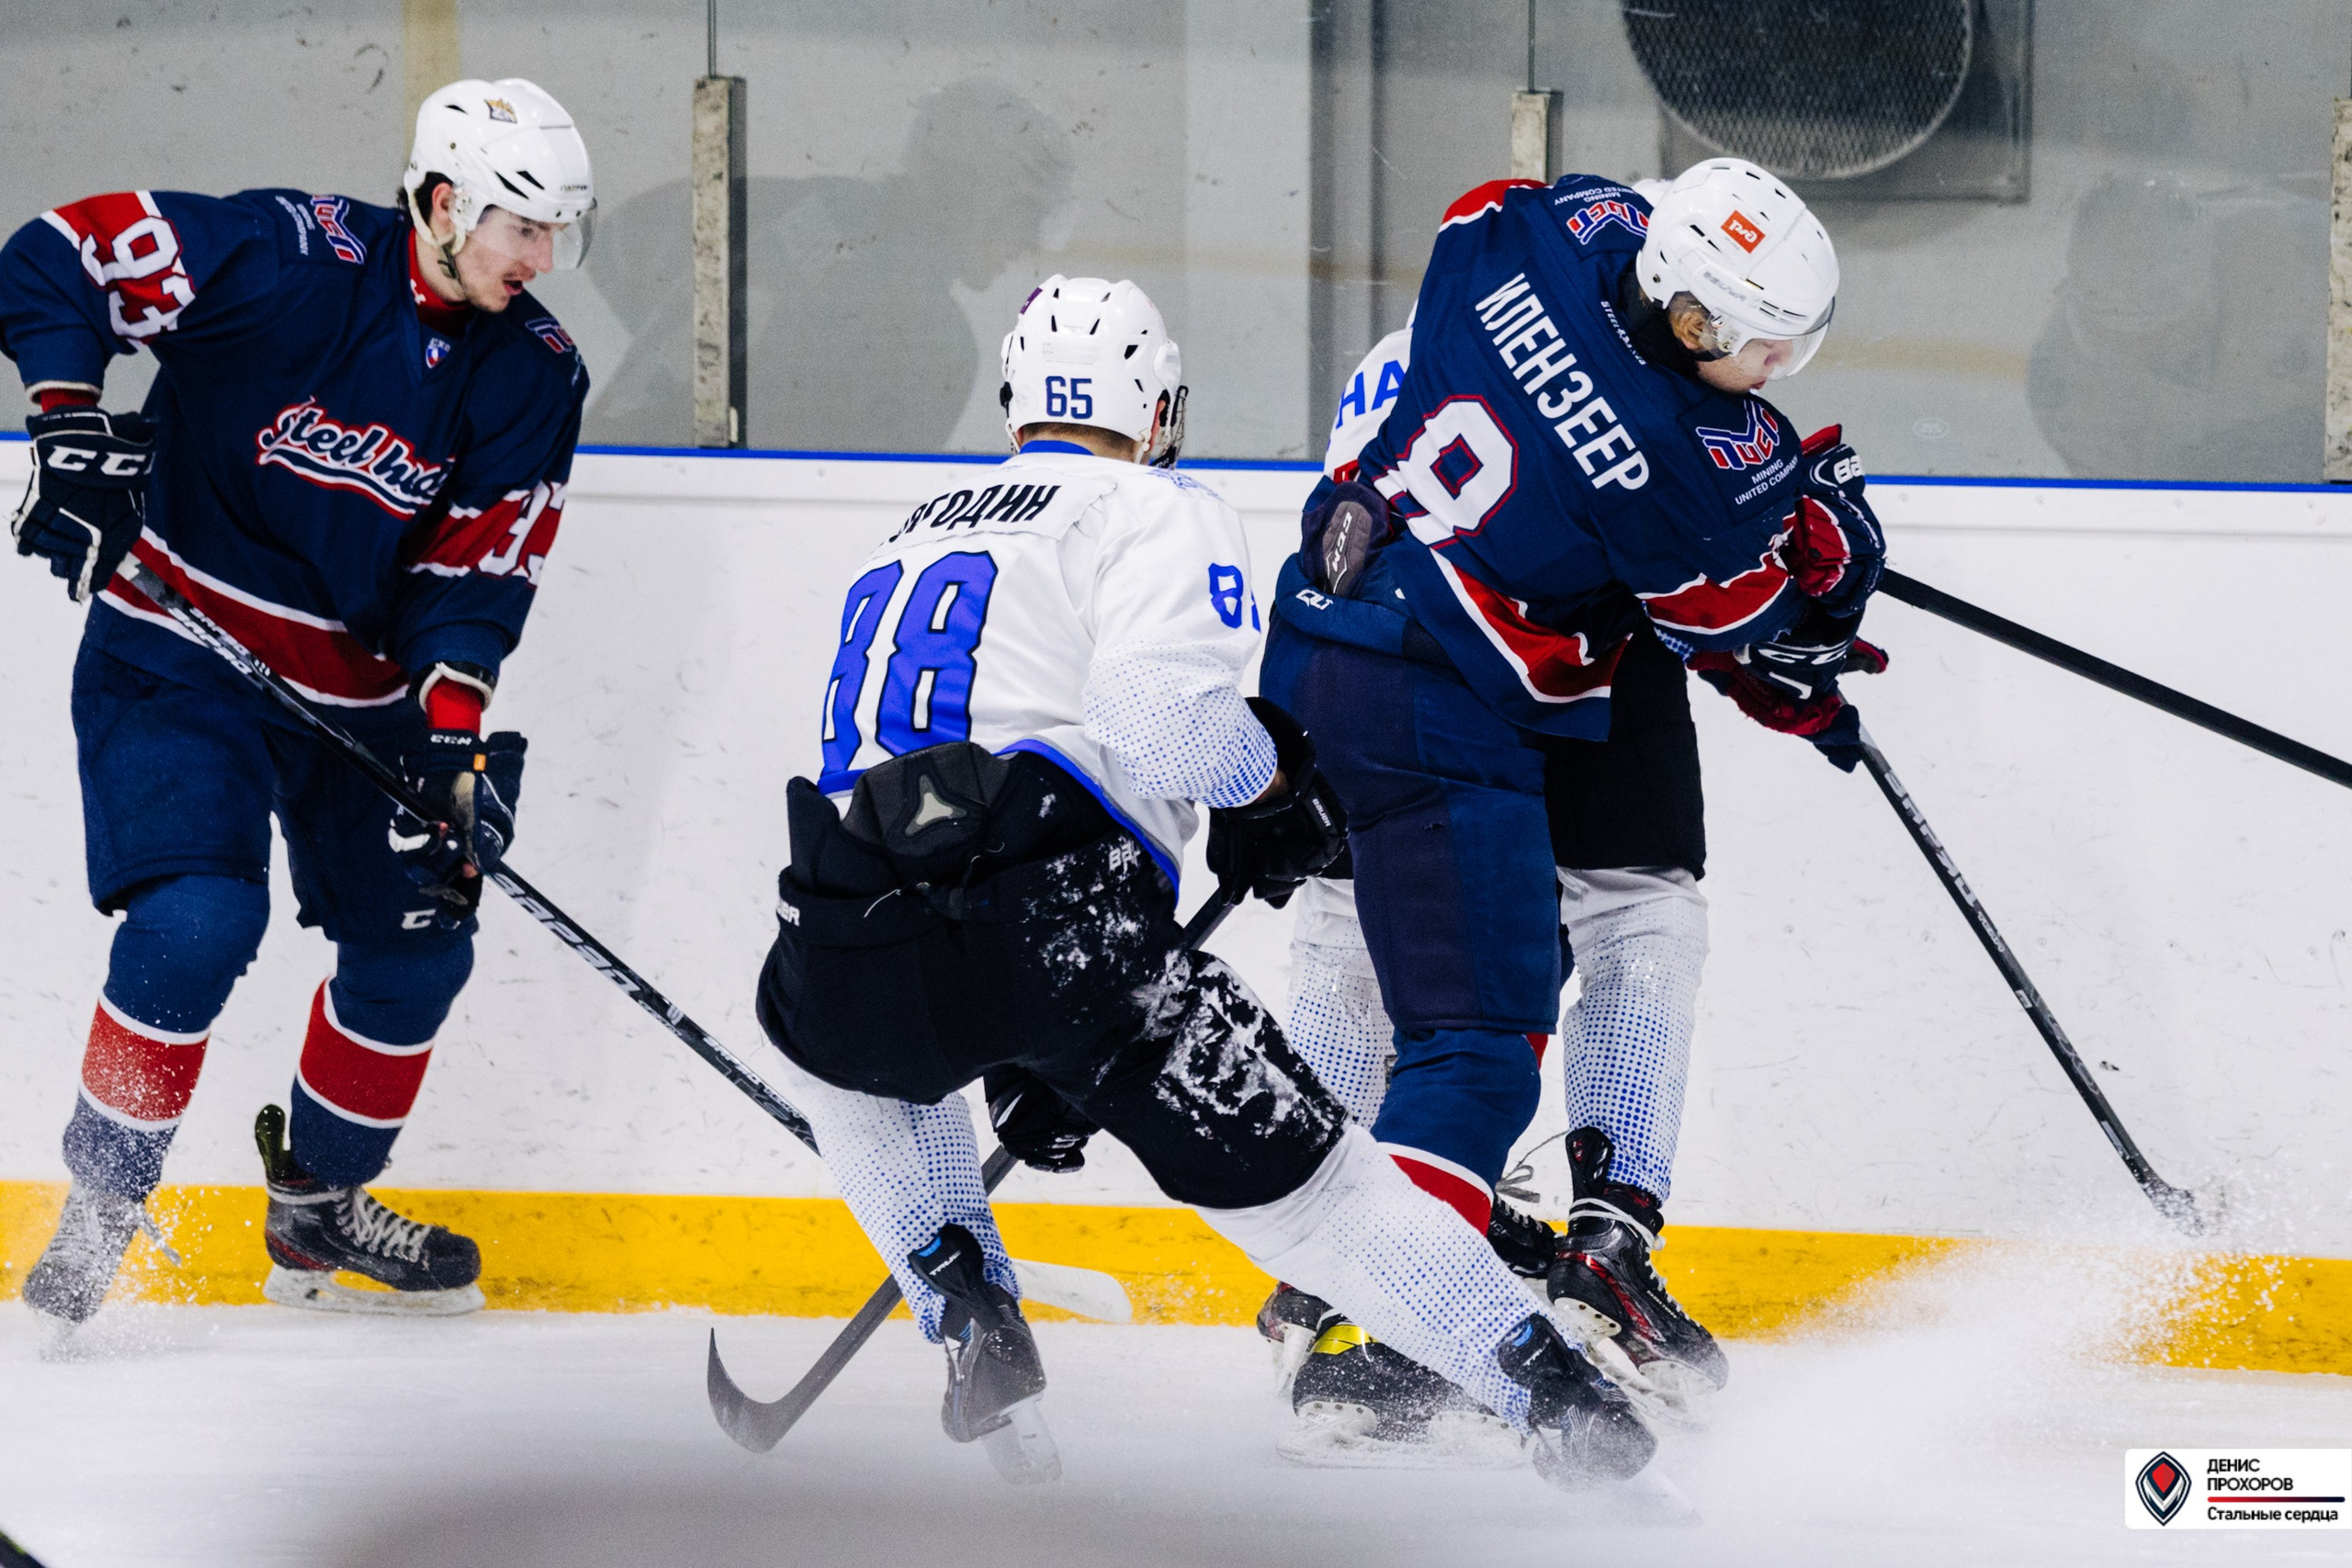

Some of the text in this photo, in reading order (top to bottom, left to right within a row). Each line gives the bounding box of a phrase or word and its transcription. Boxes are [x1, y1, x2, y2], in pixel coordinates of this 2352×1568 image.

[79, 216, 196, 339] 93
[1045, 376, 1093, 420] 65
[1475, 273, 1650, 491] ИЛЕНЗЕЕР
[47, 445, 156, 477] CC
[258, 396, 389, 468] Steel
[1735, 454, 1799, 505] UNITED COMPANY
[1751, 458, 1784, 485] MINING
[1208, 562, 1261, 634] 8
[820, 550, 999, 778] 88
